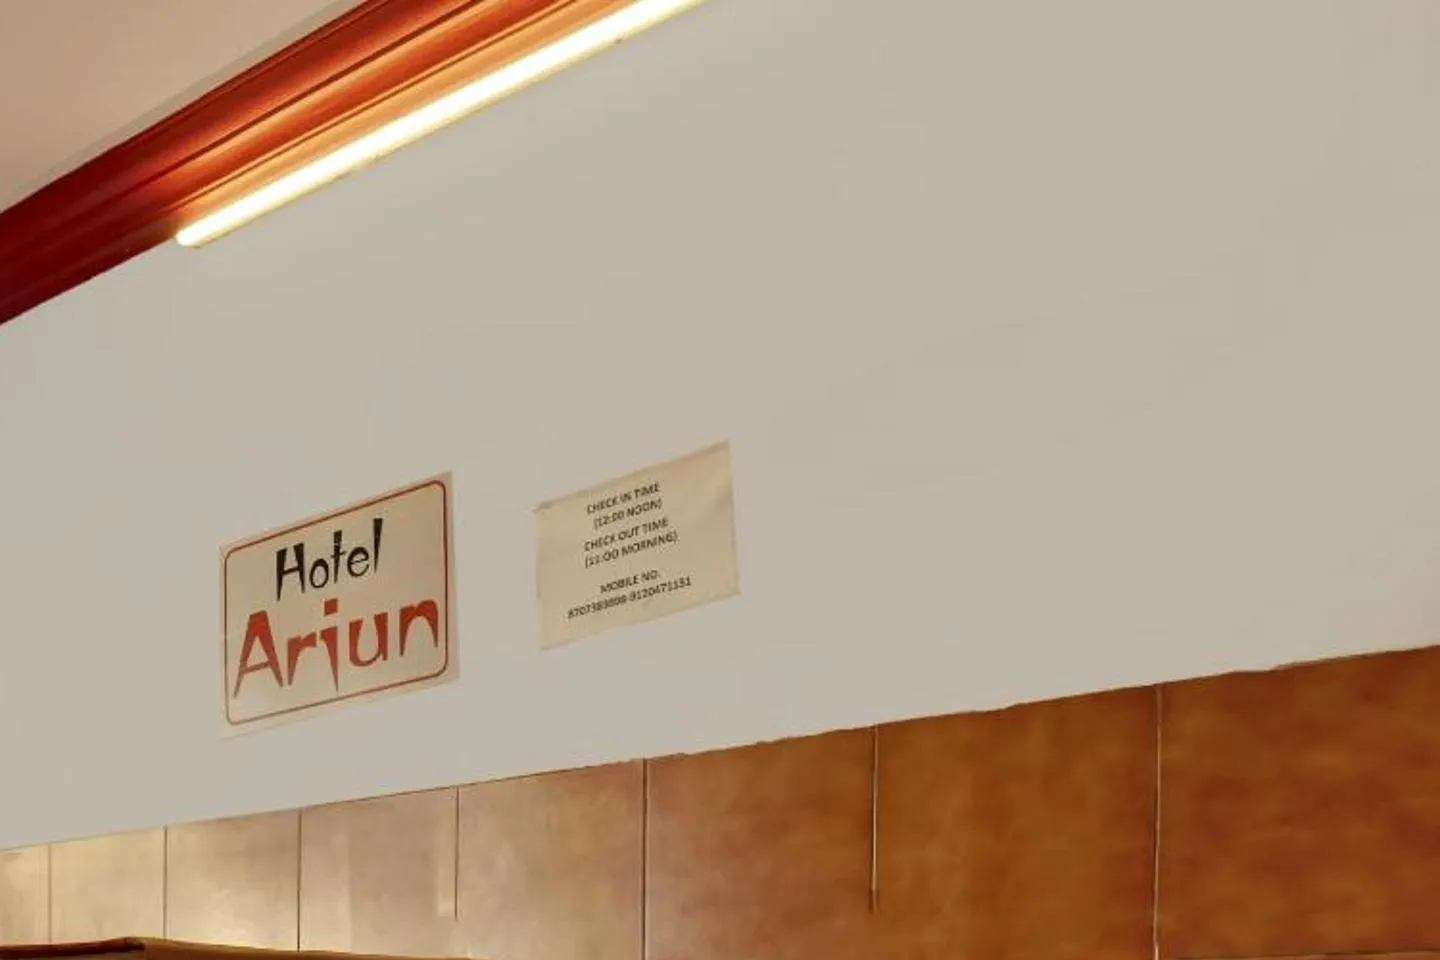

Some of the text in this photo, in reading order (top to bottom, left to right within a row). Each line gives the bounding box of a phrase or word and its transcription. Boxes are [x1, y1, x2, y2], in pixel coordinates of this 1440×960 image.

[586, 482, 661, 515] CHECK IN TIME
[626, 498, 662, 517] NOON)
[584, 516, 668, 552] CHECK OUT TIME
[621, 530, 678, 557] MORNING)
[276, 517, 383, 602] Hotel
[600, 574, 639, 594] MOBILE
[234, 598, 439, 698] Arjun
